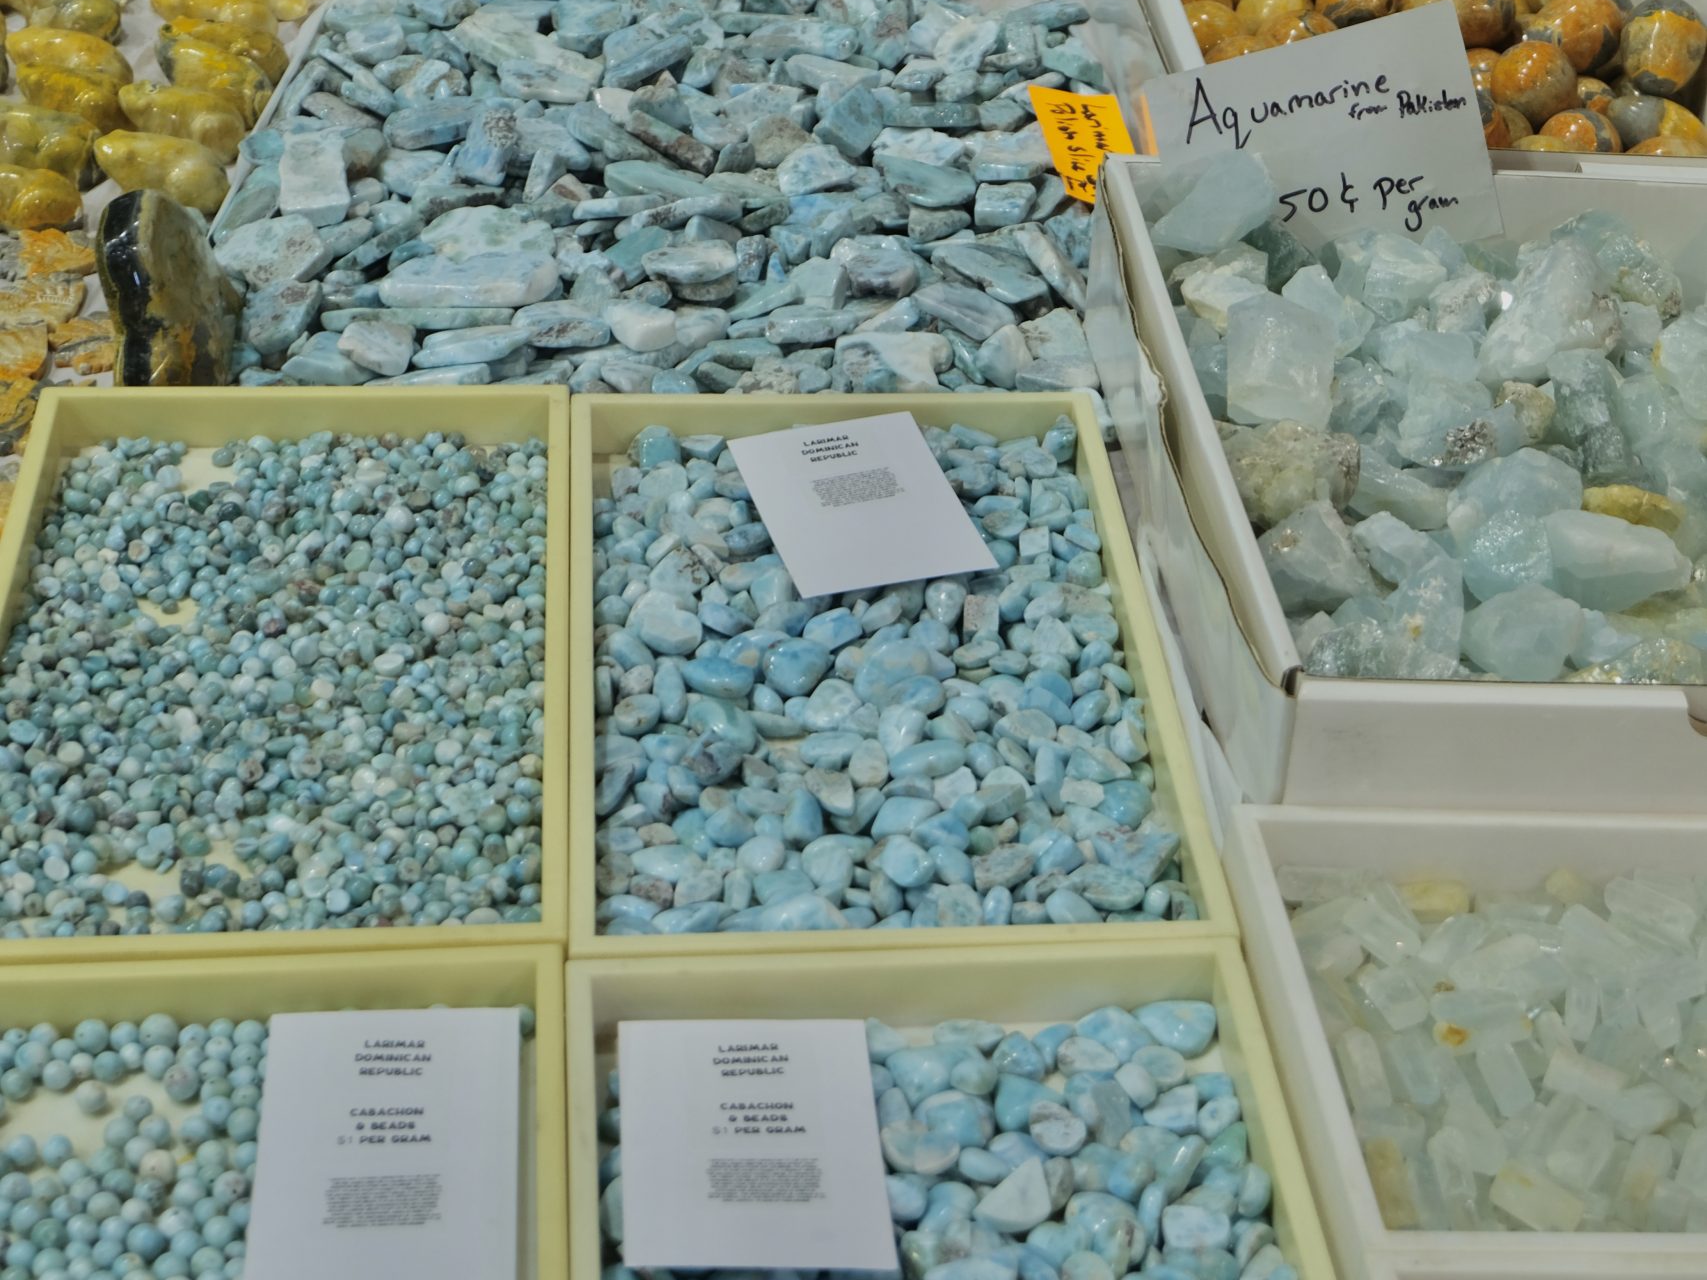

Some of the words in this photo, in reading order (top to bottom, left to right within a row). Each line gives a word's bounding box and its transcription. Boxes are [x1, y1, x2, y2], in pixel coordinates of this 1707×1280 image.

[1186, 74, 1390, 150] Aquamarine
[1404, 194, 1459, 232] gram
[803, 434, 849, 447] LARIMAR
[801, 442, 859, 455] DOMINICAN
[810, 450, 858, 462] REPUBLIC
[364, 1039, 425, 1048] LARIMAR
[718, 1043, 779, 1053] LARIMAR
[354, 1053, 432, 1062] DOMINICAN
[712, 1054, 789, 1065] DOMINICAN
[358, 1067, 423, 1076] REPUBLIC
[721, 1067, 784, 1076] REPUBLIC
[743, 1114, 788, 1122] BEADS
[370, 1121, 416, 1130] BEADS
[734, 1126, 760, 1134] PER
[766, 1125, 806, 1134] GRAM
[359, 1135, 385, 1144] PER
[390, 1134, 432, 1143] GRAM
